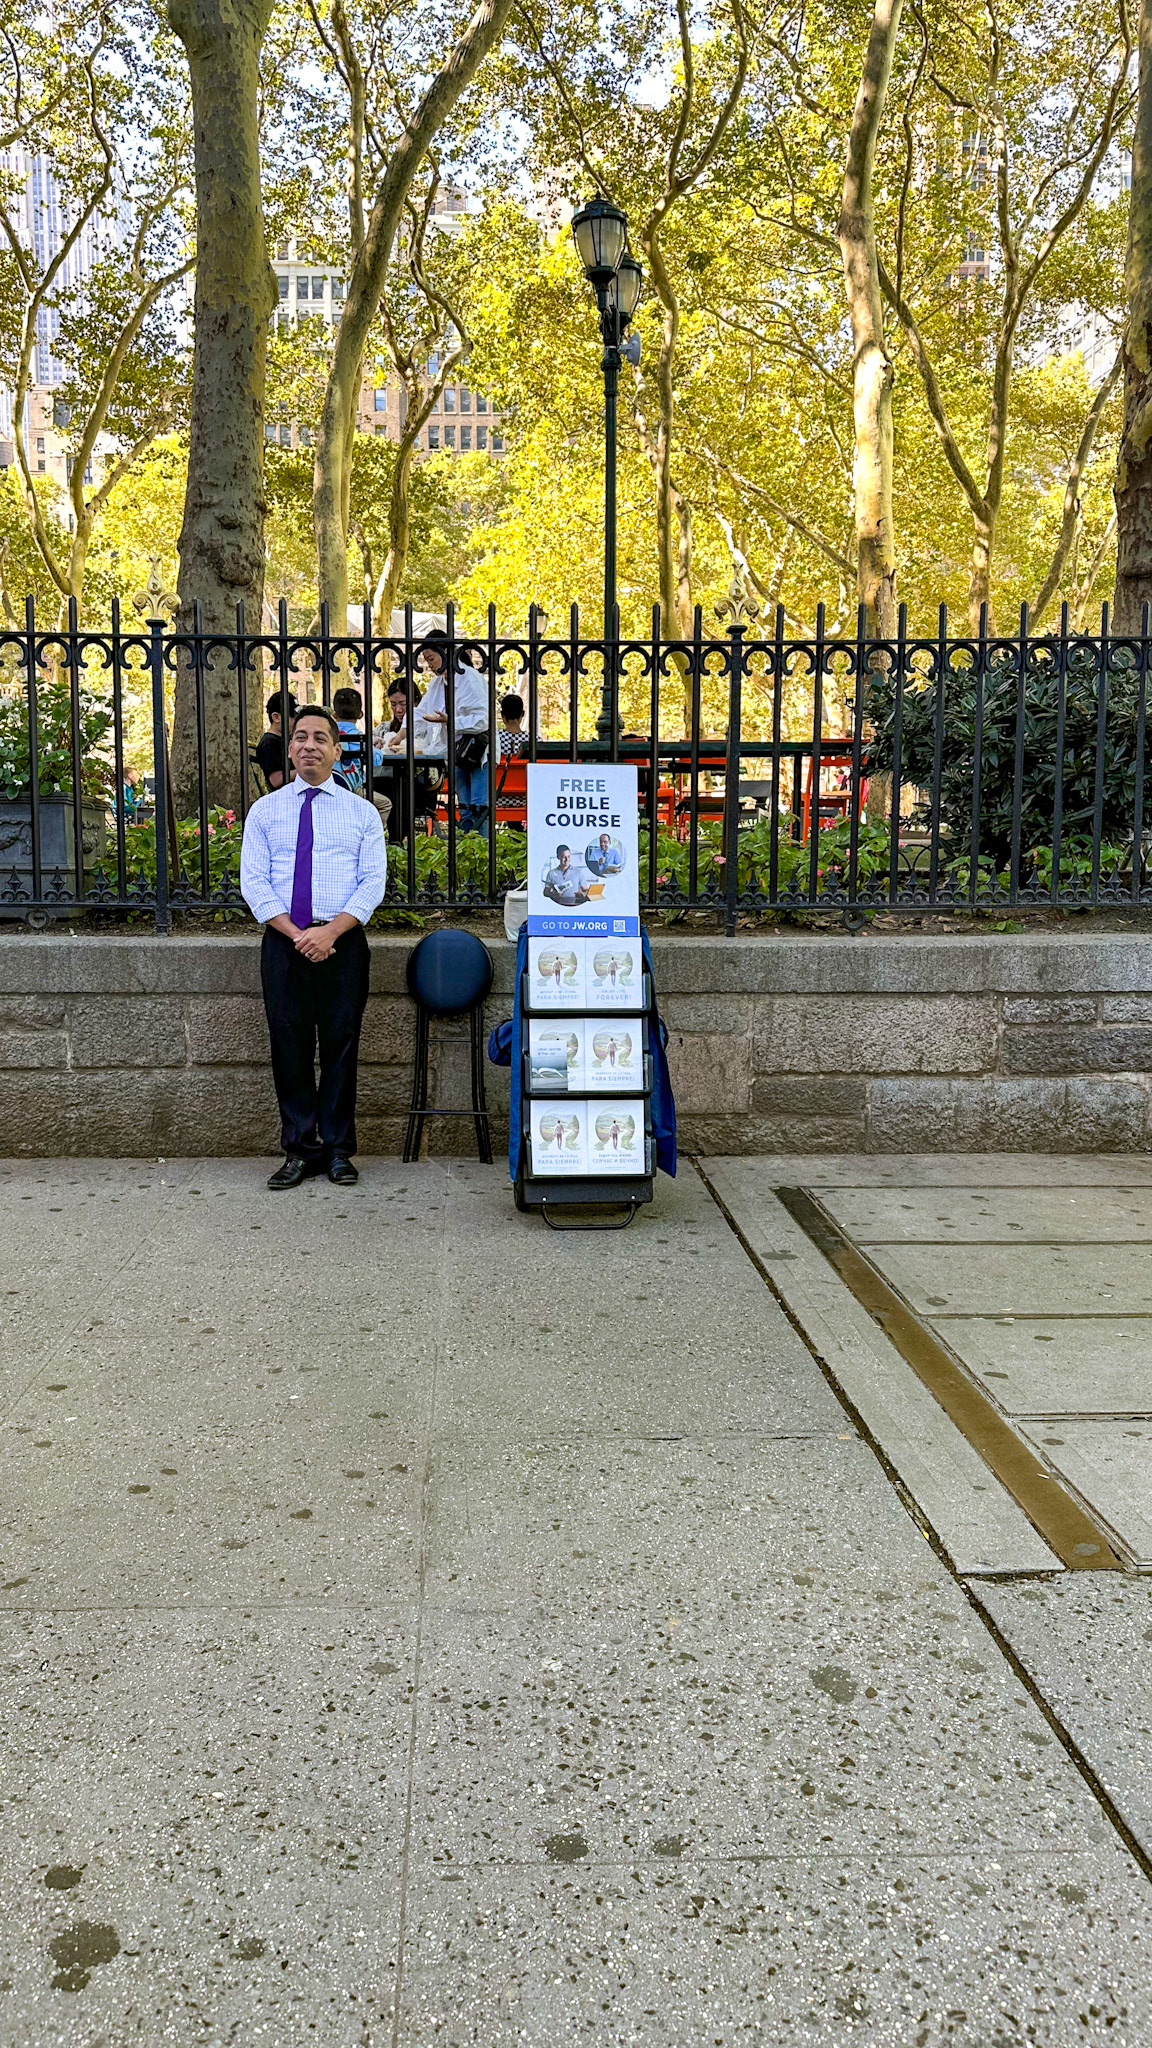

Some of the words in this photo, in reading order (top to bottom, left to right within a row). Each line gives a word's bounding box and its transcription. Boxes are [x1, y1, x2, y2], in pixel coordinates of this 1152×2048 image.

[560, 778, 606, 792] FREE
[556, 796, 610, 810] BIBLE
[545, 813, 621, 827] COURSE
[542, 921, 556, 930] GO
[557, 921, 570, 930] TO
[571, 921, 608, 931] JW.ORG
